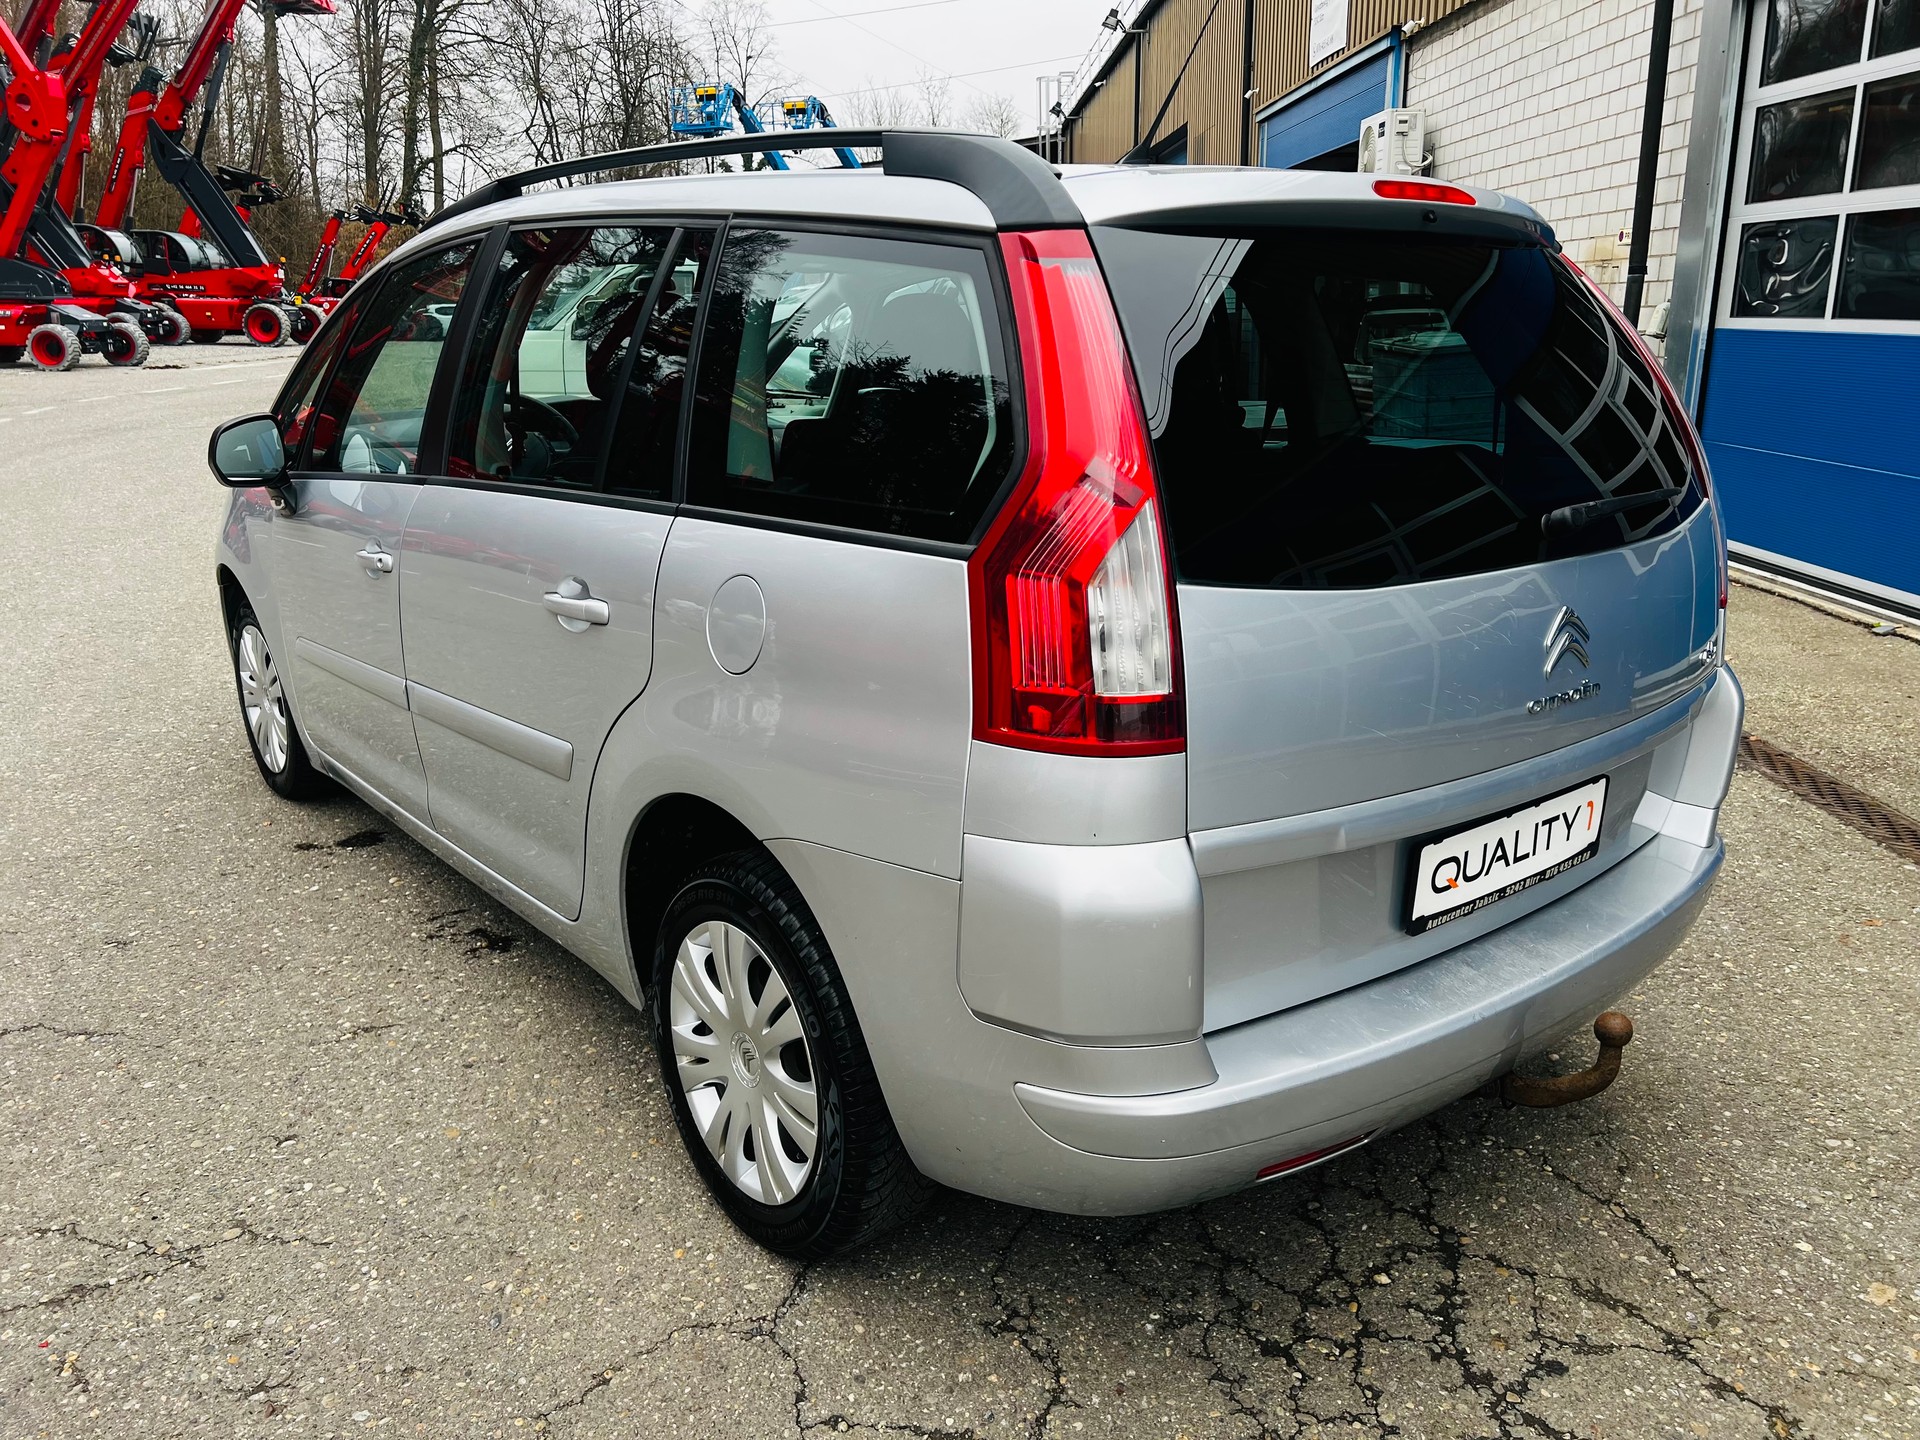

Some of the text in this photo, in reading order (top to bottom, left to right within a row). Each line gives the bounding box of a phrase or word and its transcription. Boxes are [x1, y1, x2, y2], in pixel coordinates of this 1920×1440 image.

[1426, 904, 1474, 930] Autocenter
[1504, 881, 1524, 896] 5242
[1525, 875, 1540, 888] Birr
